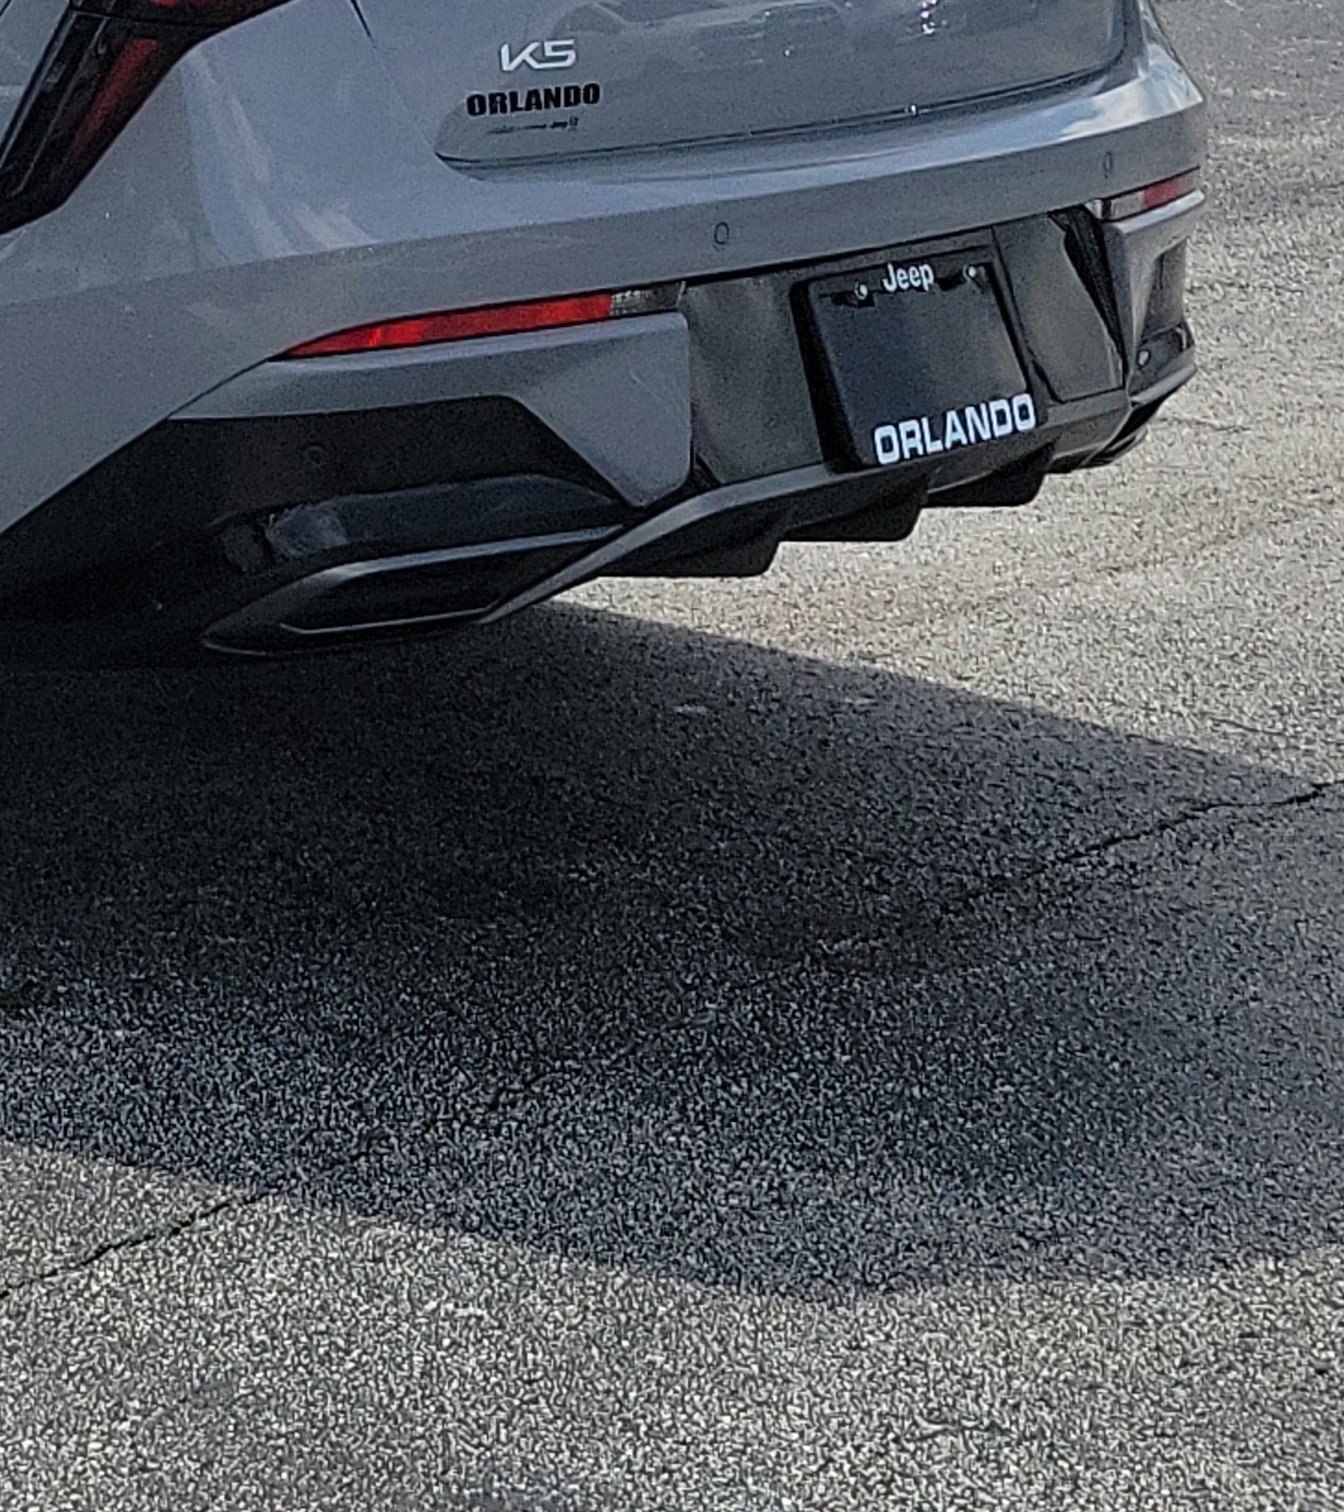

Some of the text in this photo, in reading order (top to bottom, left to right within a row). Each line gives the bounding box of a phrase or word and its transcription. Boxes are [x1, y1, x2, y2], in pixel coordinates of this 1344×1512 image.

[500, 39, 576, 72] K5
[466, 82, 601, 117] ORLANDO
[883, 263, 935, 292] Jeep
[874, 393, 1036, 465] ORLANDO
